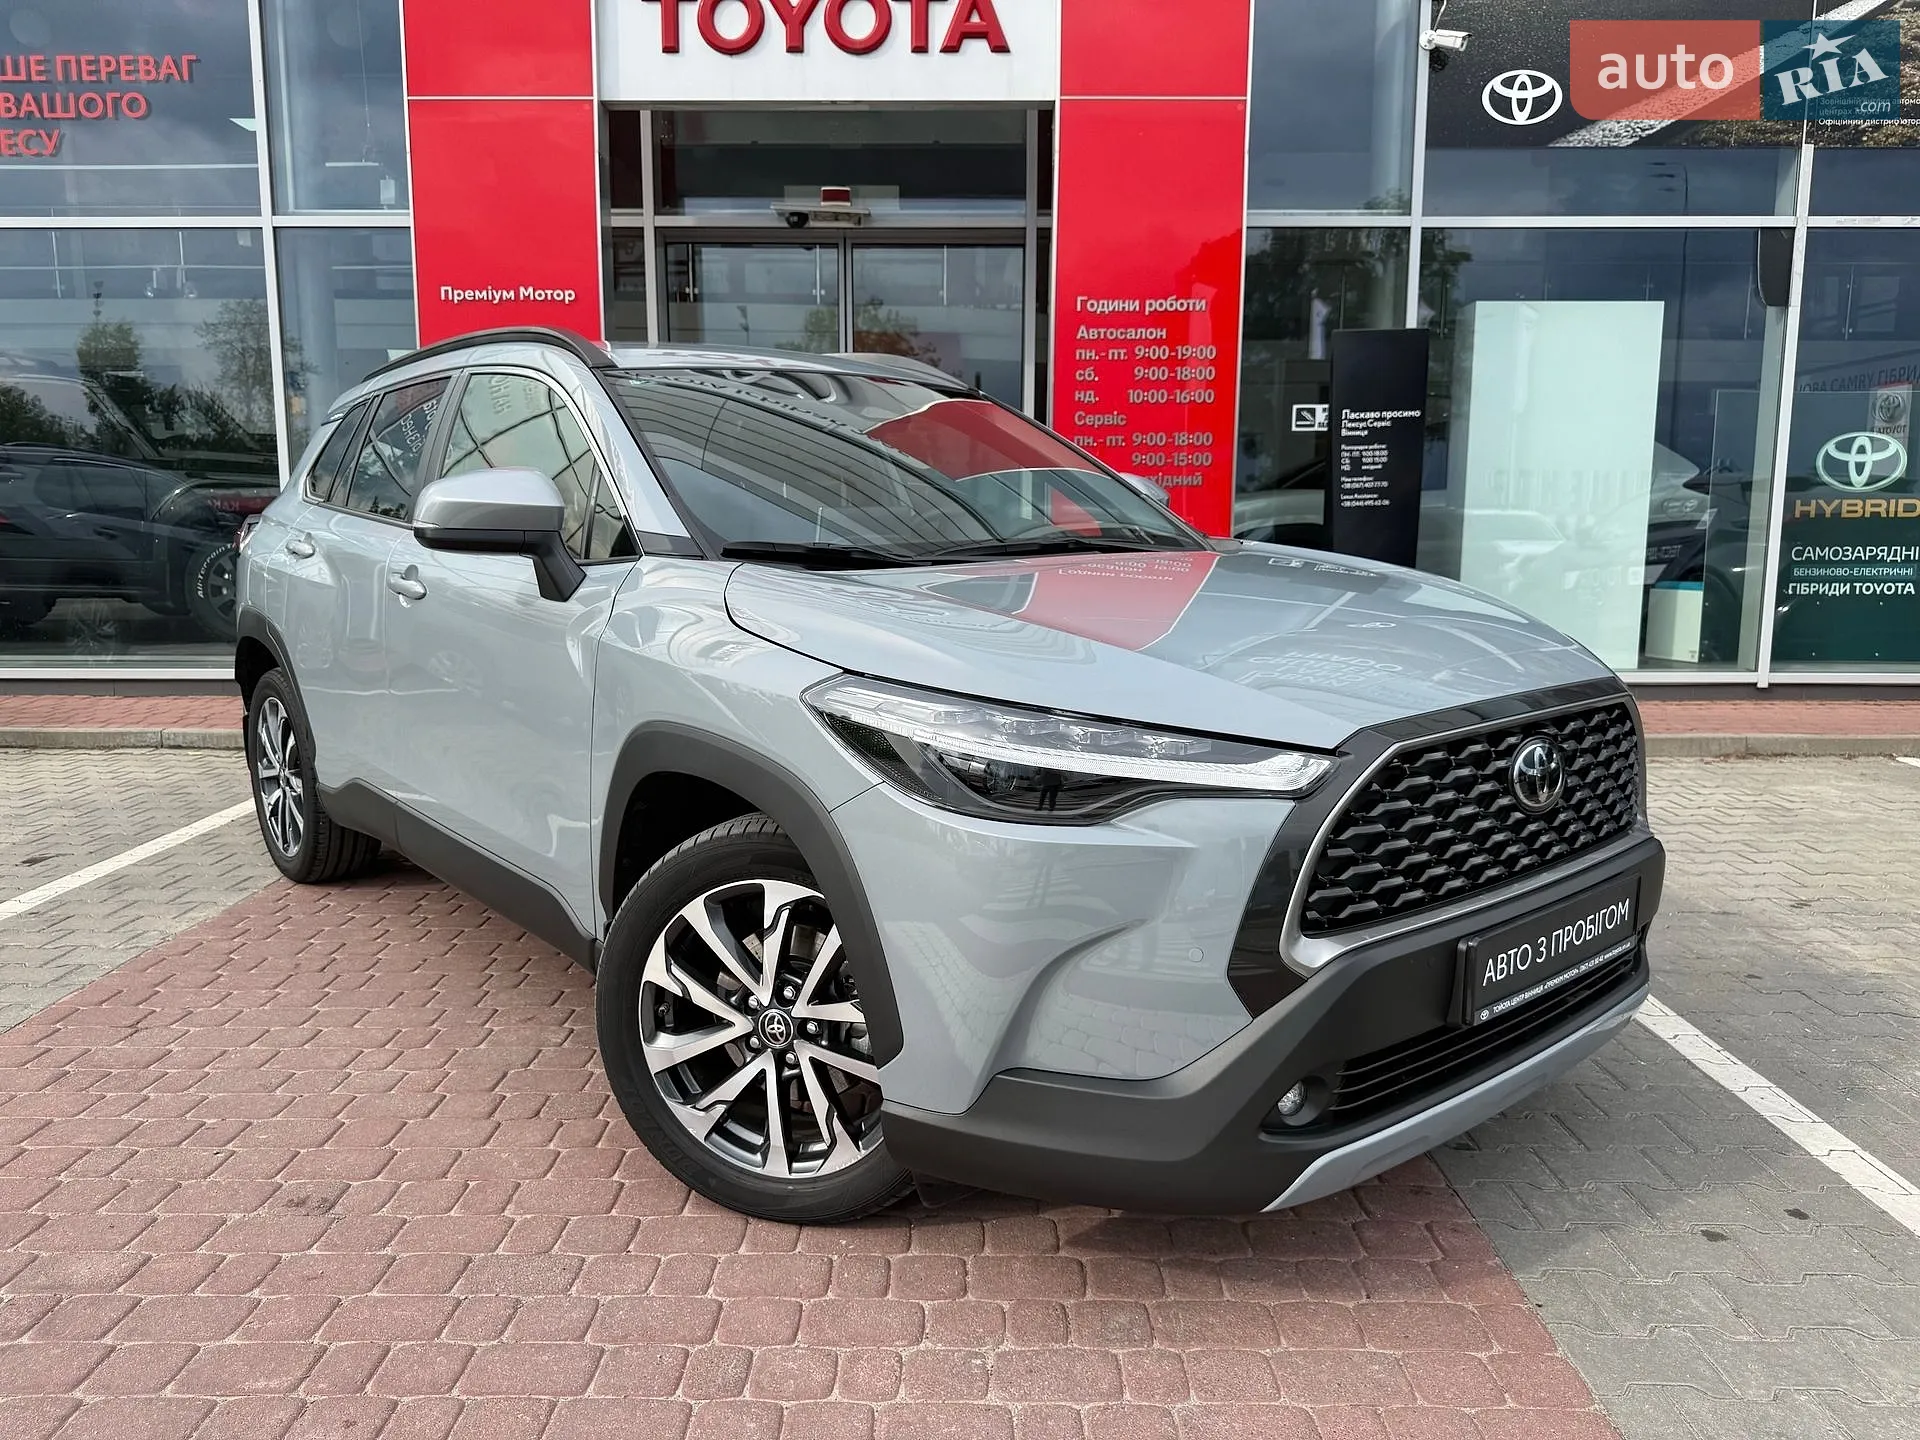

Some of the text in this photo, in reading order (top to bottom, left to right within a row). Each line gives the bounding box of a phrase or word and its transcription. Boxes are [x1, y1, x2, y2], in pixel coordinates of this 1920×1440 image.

[641, 0, 1011, 55] TOYOTA
[56, 54, 197, 82] ПЕРЕВАГ
[0, 91, 148, 119] ВАШОГО
[440, 285, 576, 304] Преміум Мотор
[1076, 295, 1207, 315] Години роботи
[1076, 324, 1167, 340] Автосалон
[1075, 367, 1099, 382] сб.
[1074, 389, 1100, 404] нд.
[1074, 410, 1127, 428] Сервіс
[1381, 409, 1421, 421] просимо
[1794, 499, 1920, 518] HYBRID
[1791, 546, 1920, 563] САМОЗАРЯДНІ
[1793, 567, 1913, 577] БЕНЗИНОВО-ЕЛЕКТРИЧНІ
[1789, 582, 1915, 597] ГІБРИДИ TOYOTA
[1482, 943, 1532, 987] АВТО
[1550, 898, 1630, 957] ПРОБІГОМ
